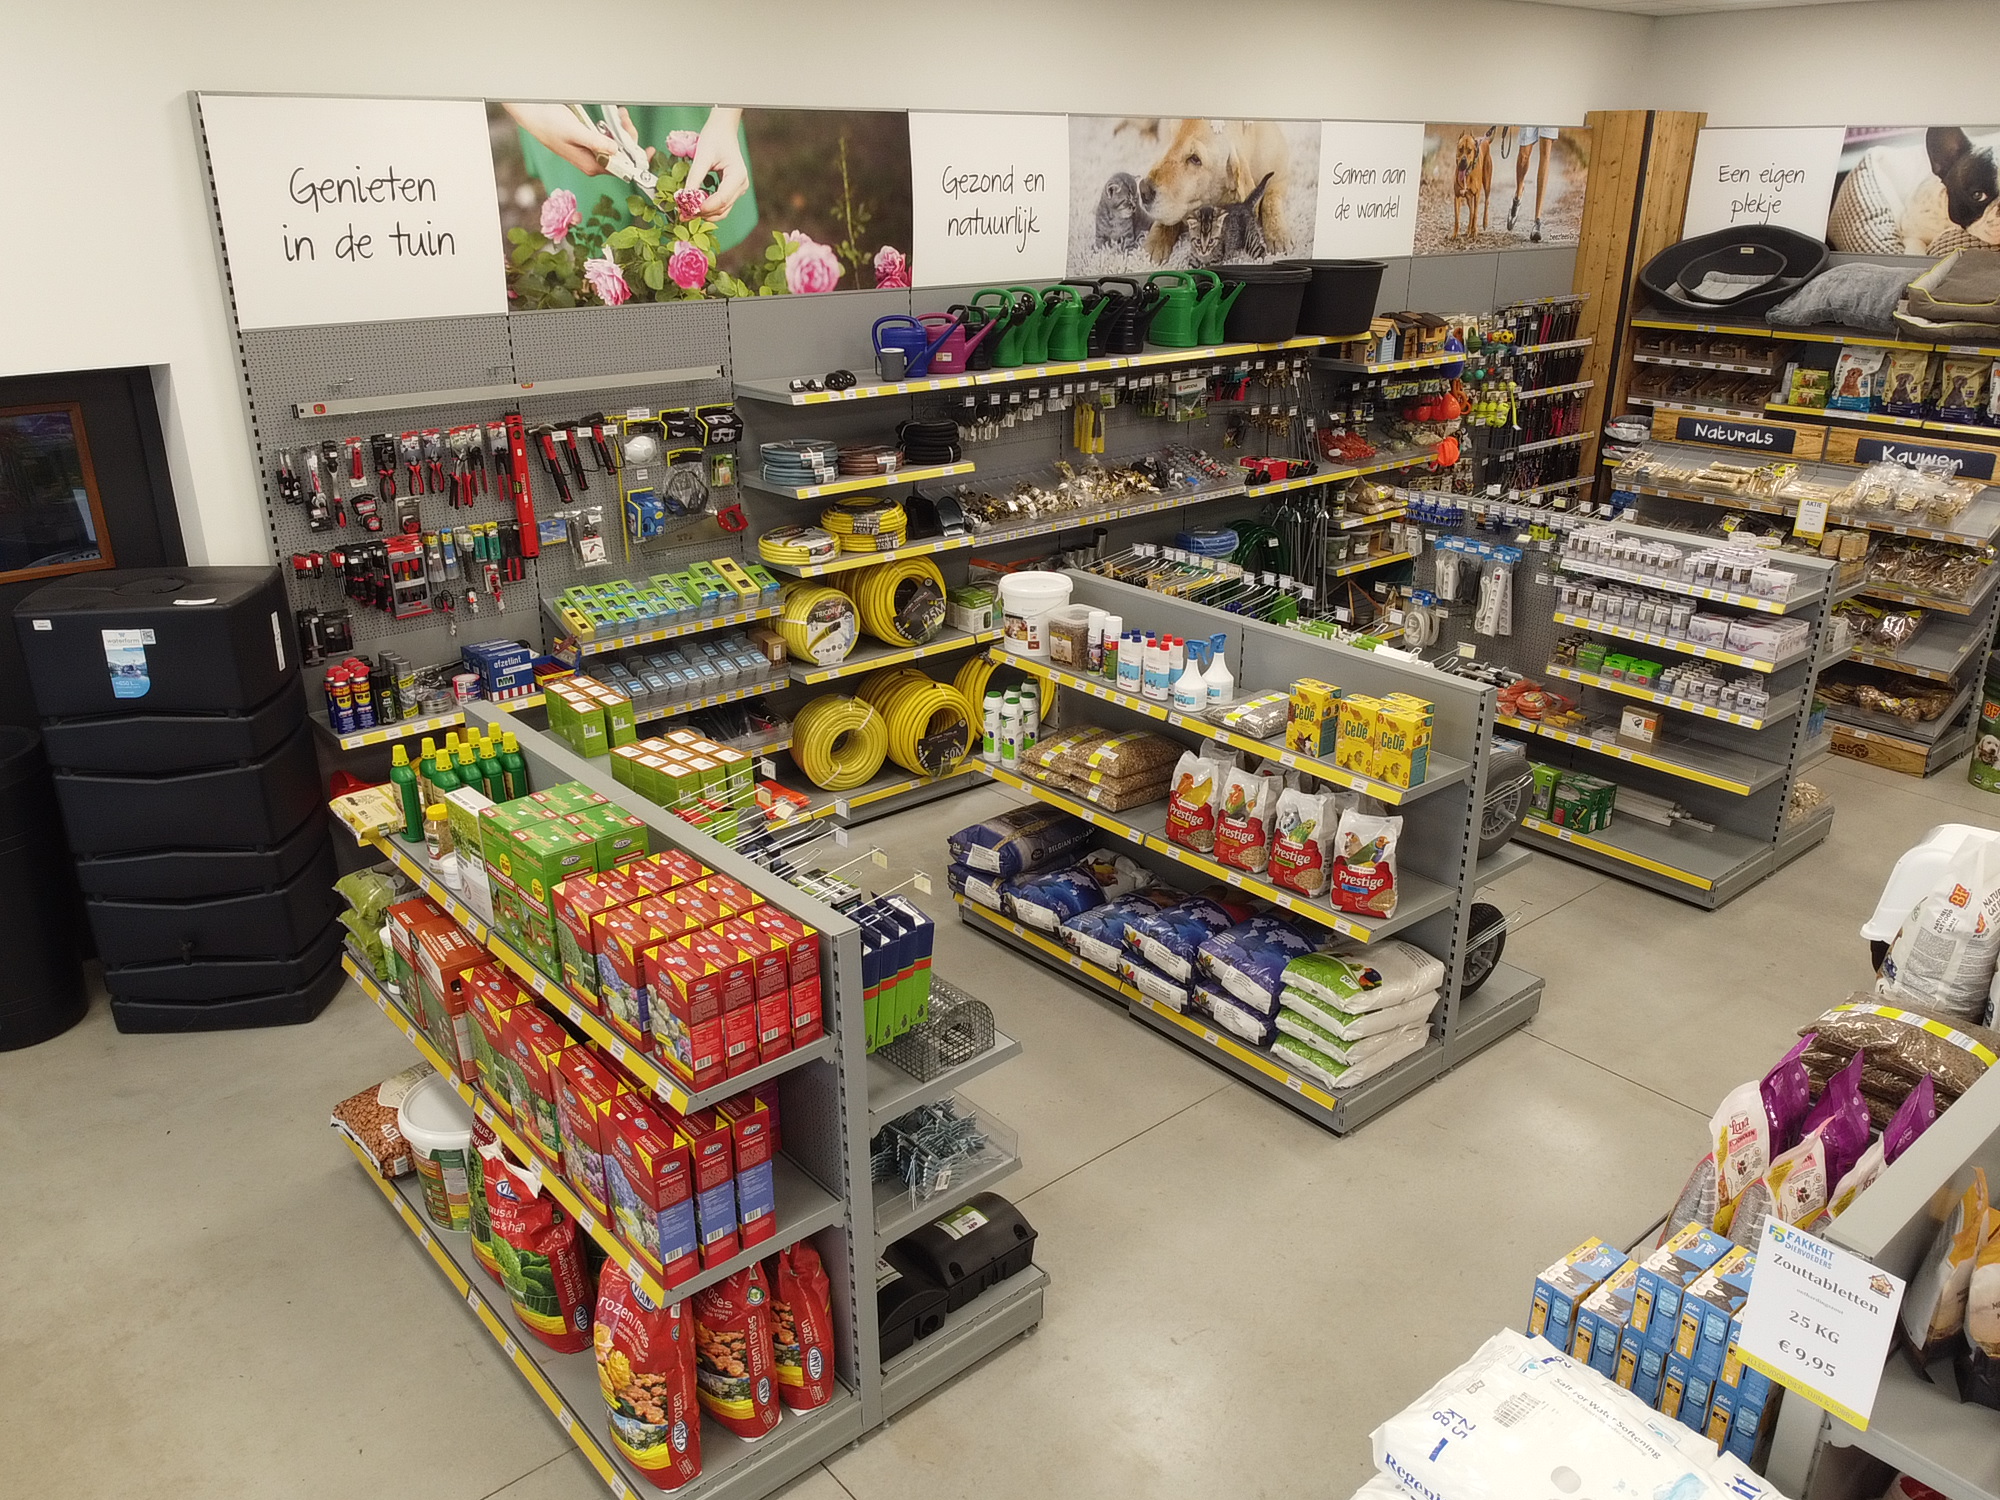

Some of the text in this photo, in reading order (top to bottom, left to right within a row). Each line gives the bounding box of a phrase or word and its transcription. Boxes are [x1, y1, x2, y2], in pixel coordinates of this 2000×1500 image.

[942, 165, 1045, 200] Gezond en
[1332, 162, 1406, 185] Samen aan
[1719, 162, 1805, 192] Een eigen
[290, 165, 436, 213] Genieten
[1334, 195, 1400, 221] de wandel
[1730, 192, 1781, 225] plekje
[283, 221, 455, 262] in de tuin
[948, 206, 1040, 253] natuurlijk
[1695, 422, 1774, 445] Naturals
[1882, 445, 1964, 469] Kauwen
[1806, 500, 1822, 508] AKTIE
[1169, 803, 1204, 826] Prestige
[1048, 839, 1071, 854] BELGIAN
[1219, 823, 1255, 844] Prestige
[1273, 843, 1311, 866] Prestige
[1339, 870, 1385, 890] Prestige
[1950, 884, 1969, 907] BF
[1785, 1241, 1832, 1270] DIERVOEDERS
[1786, 1231, 1835, 1260] FAKKERT
[1773, 1253, 1879, 1315] Zouttabletten
[599, 1296, 649, 1348] rozen/roses
[801, 1319, 812, 1344] ozen
[1789, 1309, 1840, 1345] 25 KG
[1746, 1356, 1767, 1374] ALLES
[1768, 1366, 1786, 1382] VOOR
[1778, 1338, 1837, 1378] € 9,95
[1432, 1408, 1464, 1426] kg
[1451, 1417, 1477, 1439] 25
[1554, 1378, 1573, 1391] Salt
[1617, 1421, 1661, 1460] Softening
[1384, 1451, 1450, 1500] Regeni
